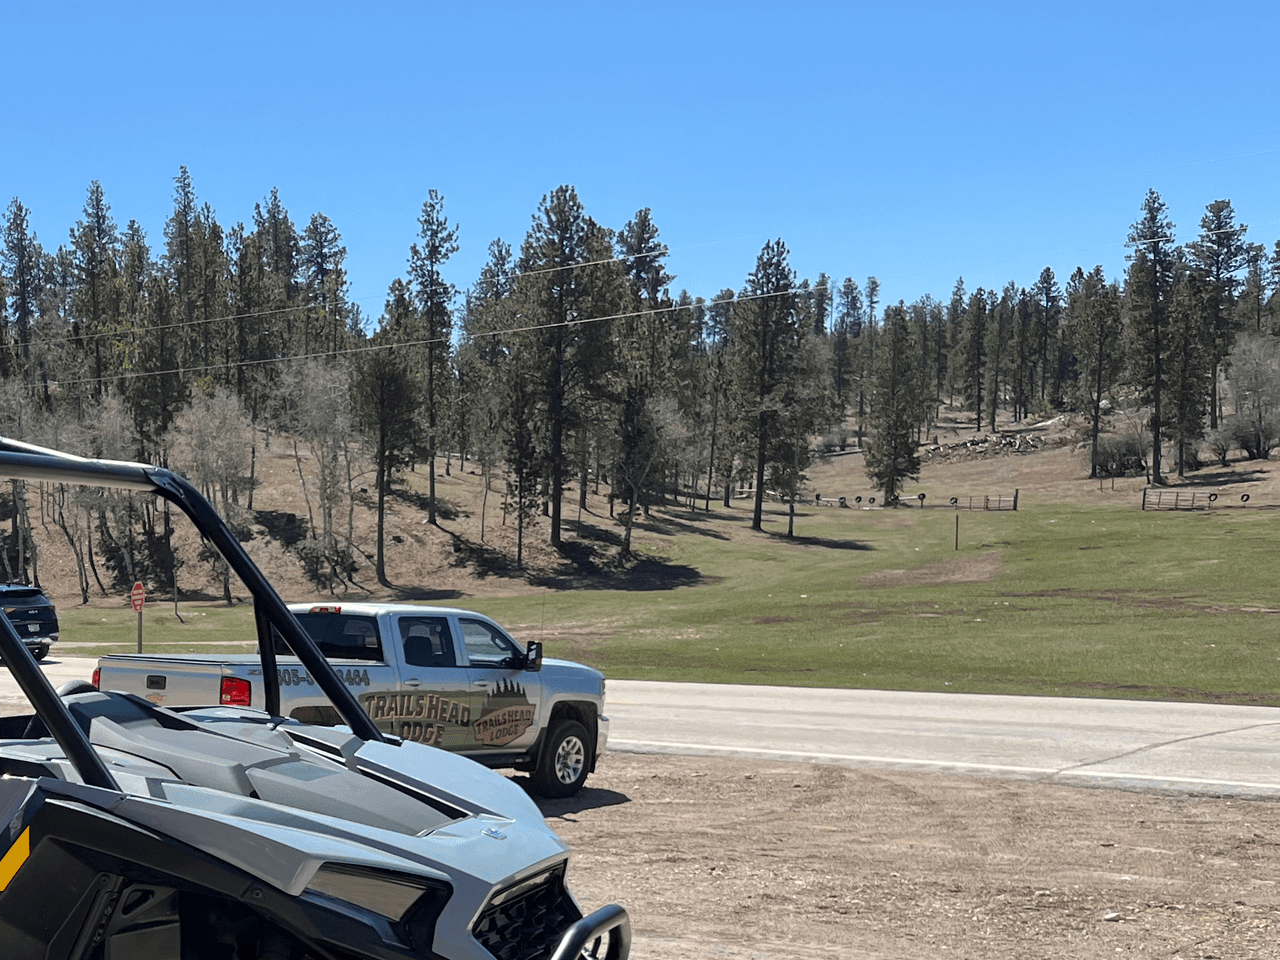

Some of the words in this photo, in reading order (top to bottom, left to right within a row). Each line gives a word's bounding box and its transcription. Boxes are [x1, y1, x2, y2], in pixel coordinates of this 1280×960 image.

[365, 694, 471, 727] TRAILSHEAD
[476, 709, 532, 735] TRAILSHEAD
[489, 723, 520, 742] LODGE
